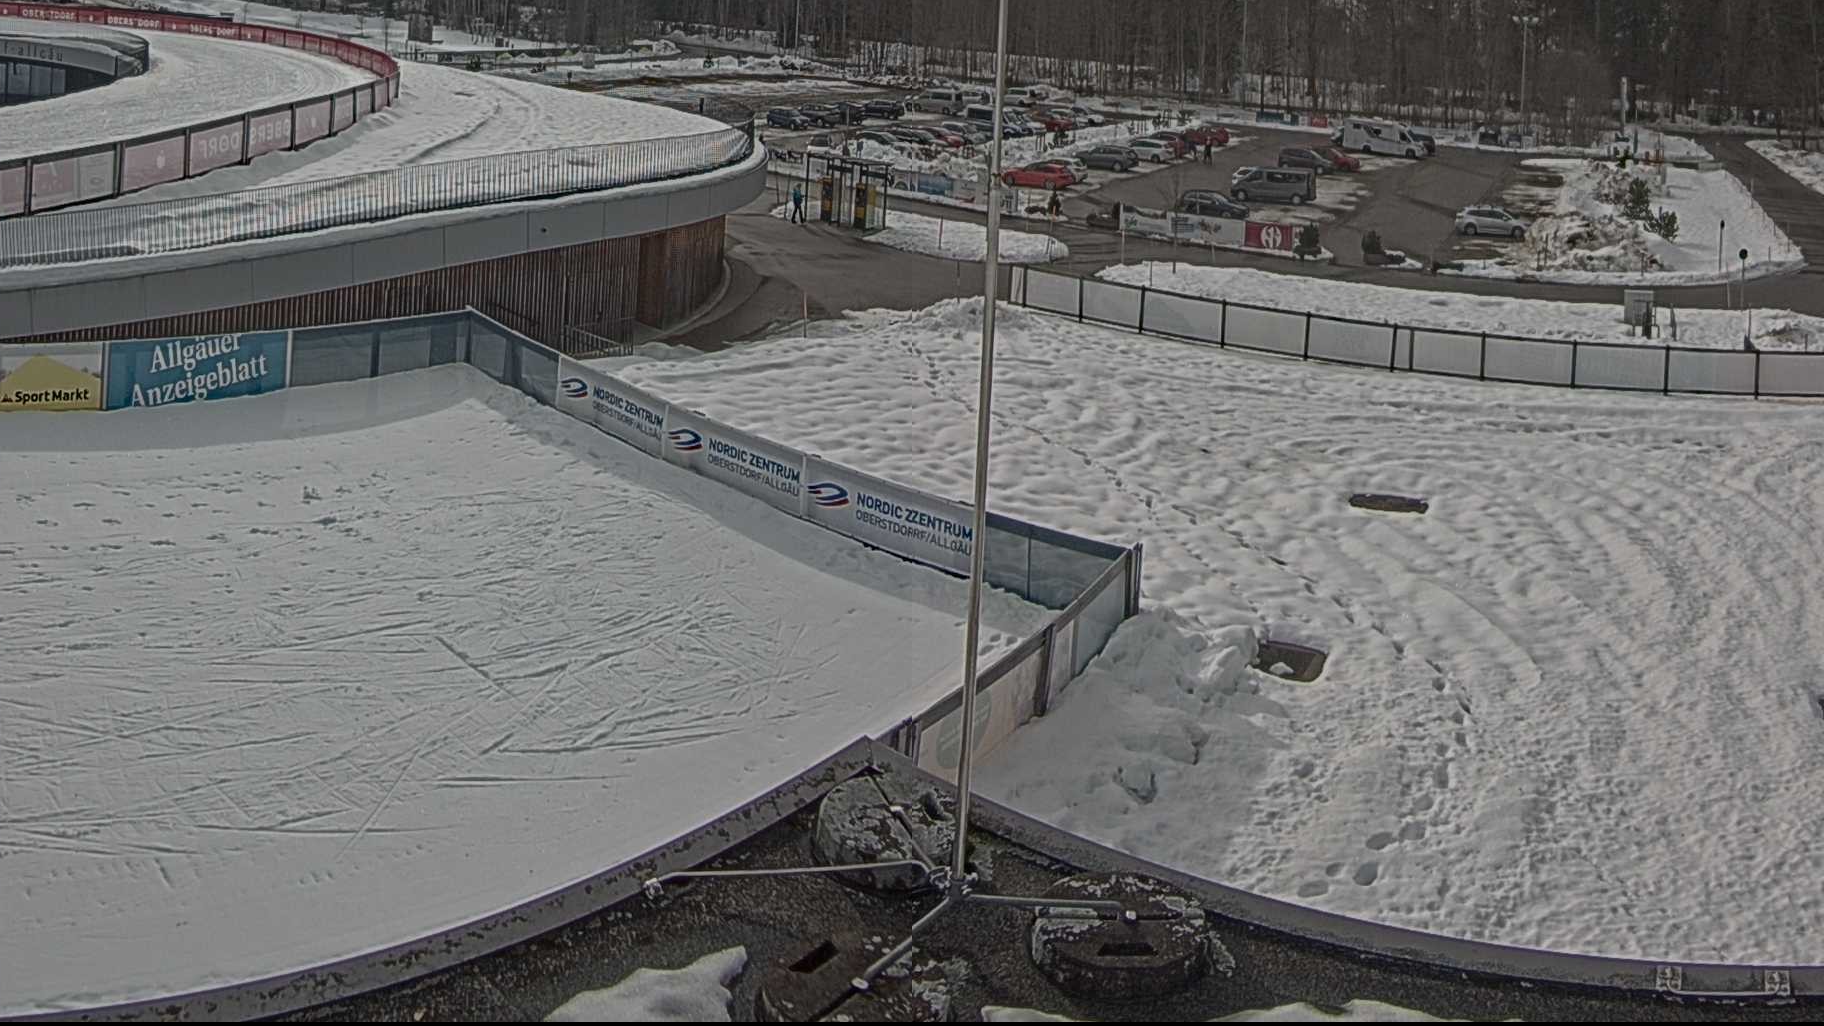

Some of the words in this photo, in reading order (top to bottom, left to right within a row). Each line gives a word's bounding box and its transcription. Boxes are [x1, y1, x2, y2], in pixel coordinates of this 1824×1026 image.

[22, 9, 76, 21] OBERTDORF
[107, 15, 161, 29] OBERSDORF
[149, 333, 242, 372] Allgäuer
[15, 389, 50, 405] Sport
[51, 388, 89, 402] Markt
[131, 354, 268, 407] Anzeigeblatt
[592, 385, 624, 409] NORDIC
[625, 399, 664, 429] ZENTRUM
[708, 437, 749, 464] NORDIC
[749, 452, 801, 484] ZENTRUM
[856, 491, 904, 519] NORDIC
